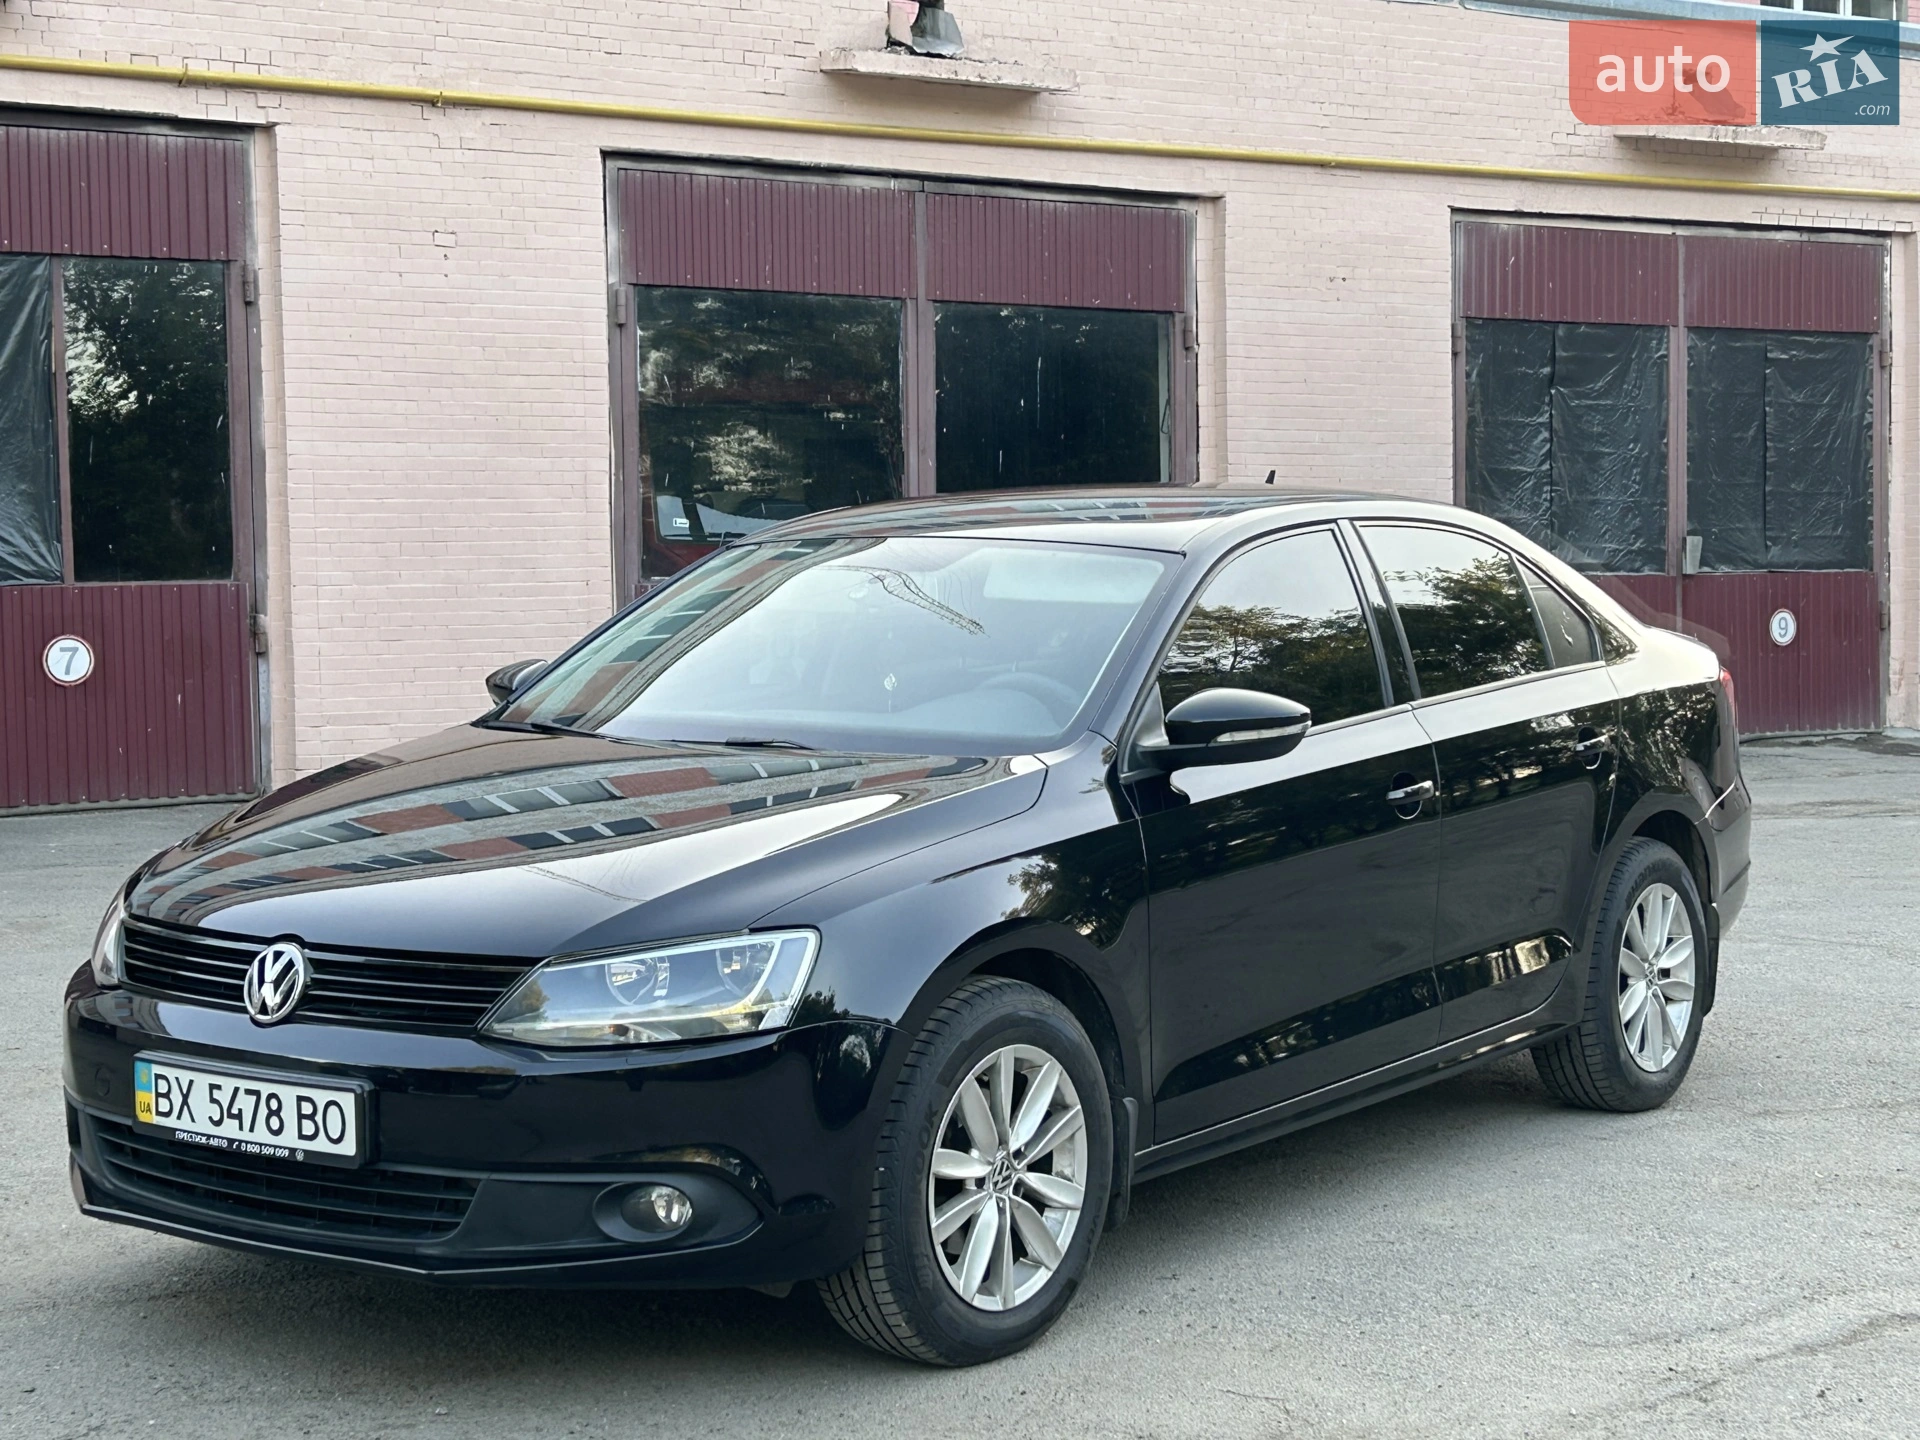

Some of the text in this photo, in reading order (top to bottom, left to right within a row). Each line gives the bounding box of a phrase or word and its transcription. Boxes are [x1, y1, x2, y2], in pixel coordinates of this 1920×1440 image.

[1778, 616, 1788, 638] 9
[59, 646, 79, 675] 7
[139, 1100, 152, 1116] UA
[153, 1072, 347, 1145] BX 5478 BO
[246, 1143, 260, 1154] 800
[261, 1145, 275, 1155] 509
